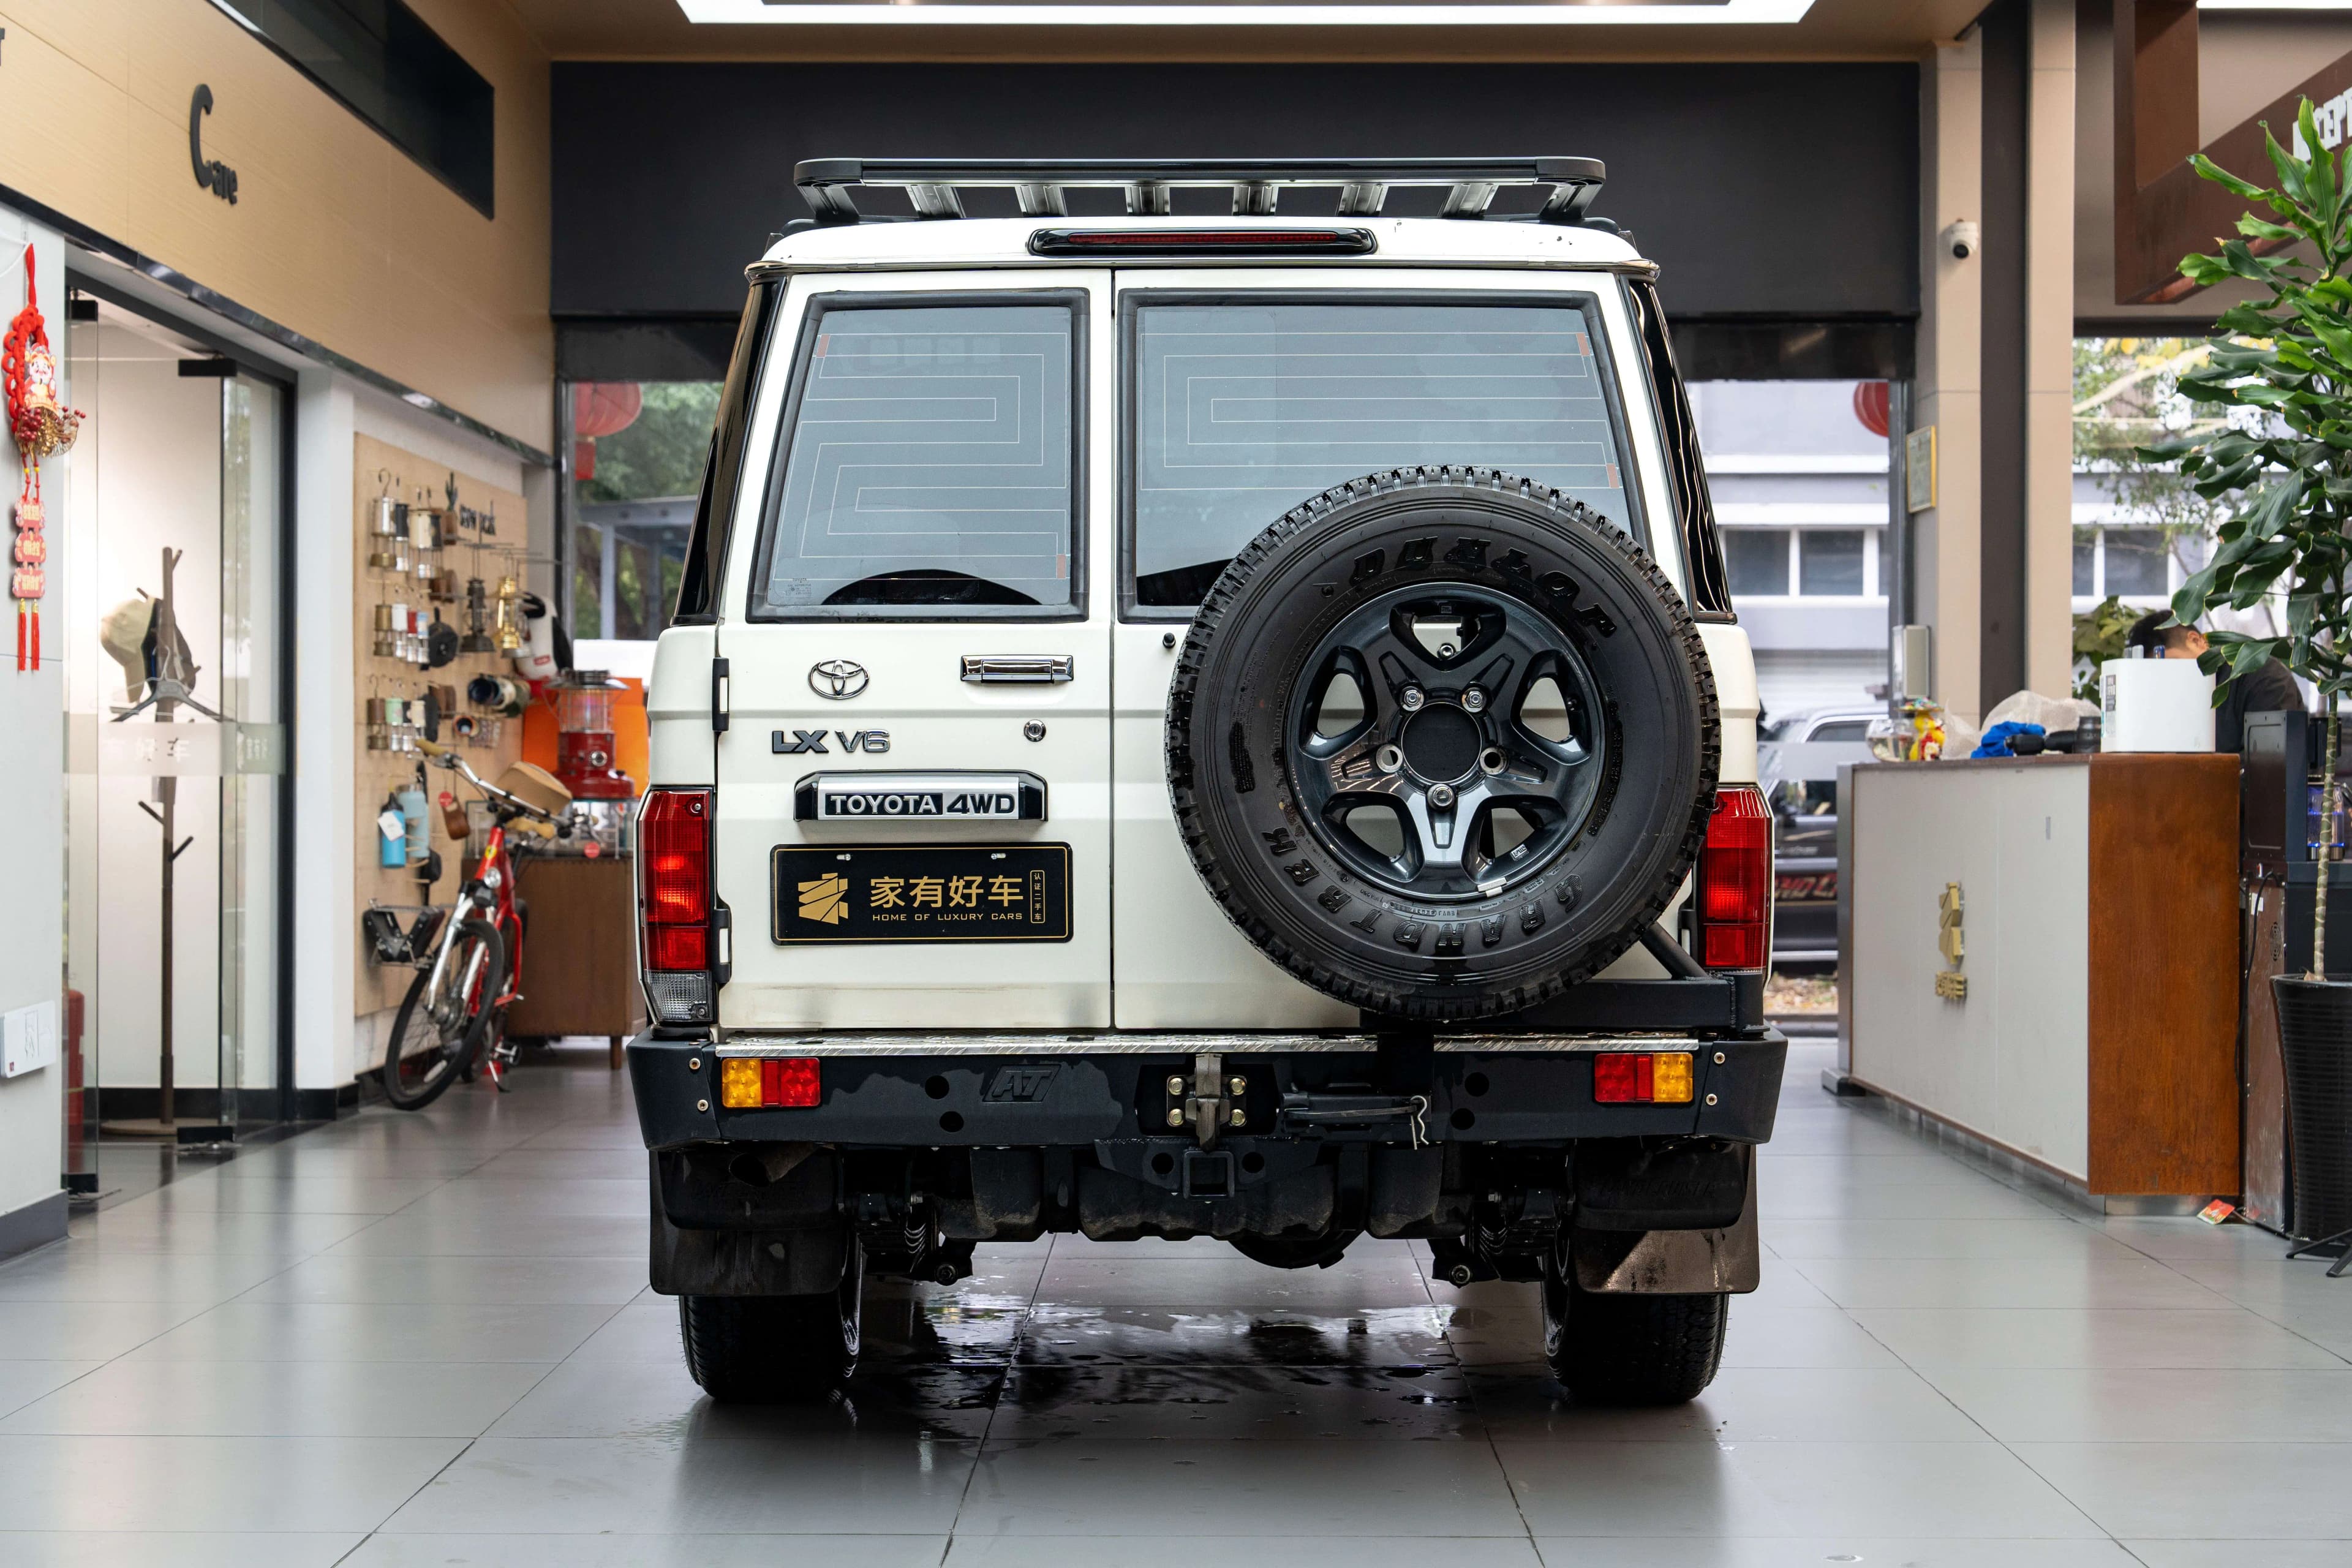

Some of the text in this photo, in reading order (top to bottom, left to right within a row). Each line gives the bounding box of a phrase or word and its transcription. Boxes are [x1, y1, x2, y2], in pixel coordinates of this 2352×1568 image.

[190, 83, 238, 205] Care
[1349, 536, 1618, 638] DUNLOP
[772, 729, 891, 754] LX V6
[831, 793, 1016, 815] TOYOTA 4WD
[870, 875, 1023, 908] 家有好车
[1033, 873, 1042, 921] 认证二手车
[992, 1070, 1052, 1098] AT
